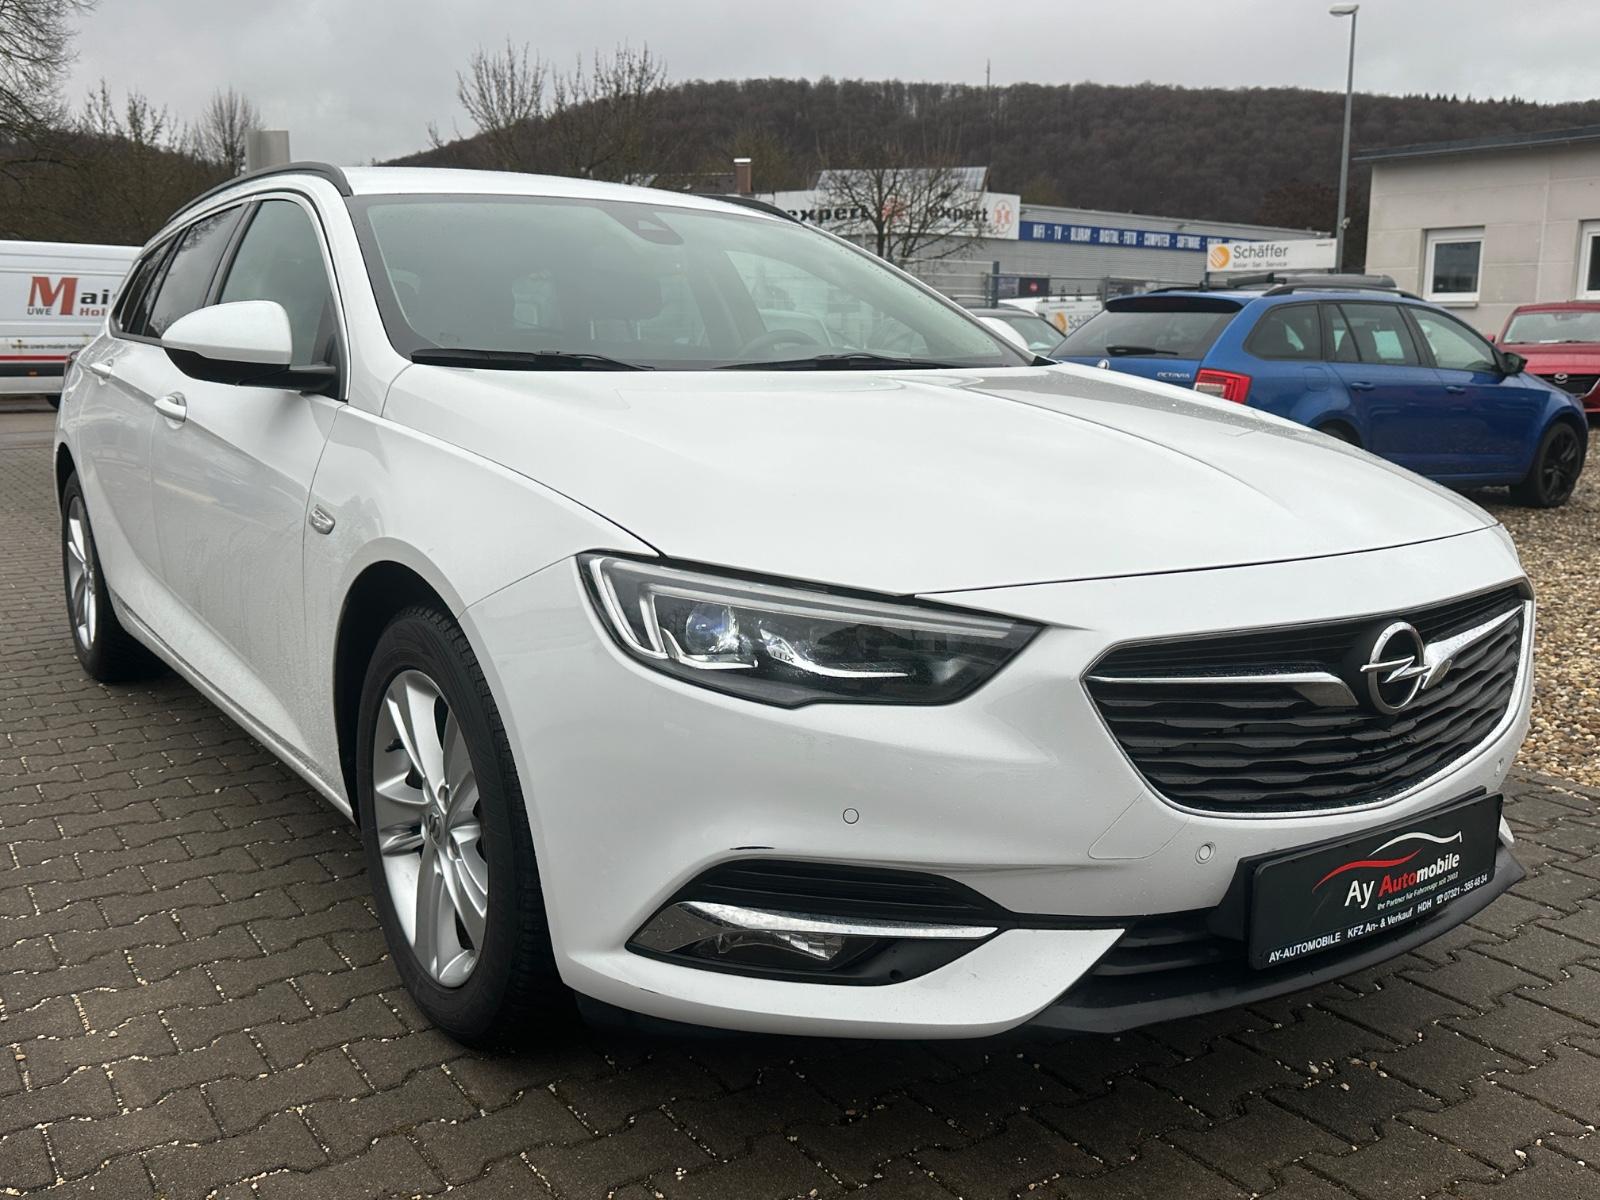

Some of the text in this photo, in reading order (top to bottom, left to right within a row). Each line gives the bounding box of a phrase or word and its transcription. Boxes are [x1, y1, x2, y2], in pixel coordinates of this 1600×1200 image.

[929, 206, 988, 222] expert
[1054, 225, 1062, 240] TV
[1233, 244, 1288, 259] Schäffer
[28, 276, 117, 316] Mai
[27, 307, 53, 316] UWE
[1156, 371, 1190, 379] OCTAVIA
[1344, 852, 1460, 909] Ay Automobile
[1386, 895, 1406, 908] Partner
[1268, 932, 1342, 963] AY-AUTOMOBILE
[1347, 924, 1364, 939] KFZ
[1365, 922, 1379, 934] An-
[1379, 917, 1386, 928] &
[1387, 907, 1413, 926] Verkauf
[1417, 899, 1432, 914] HDH
